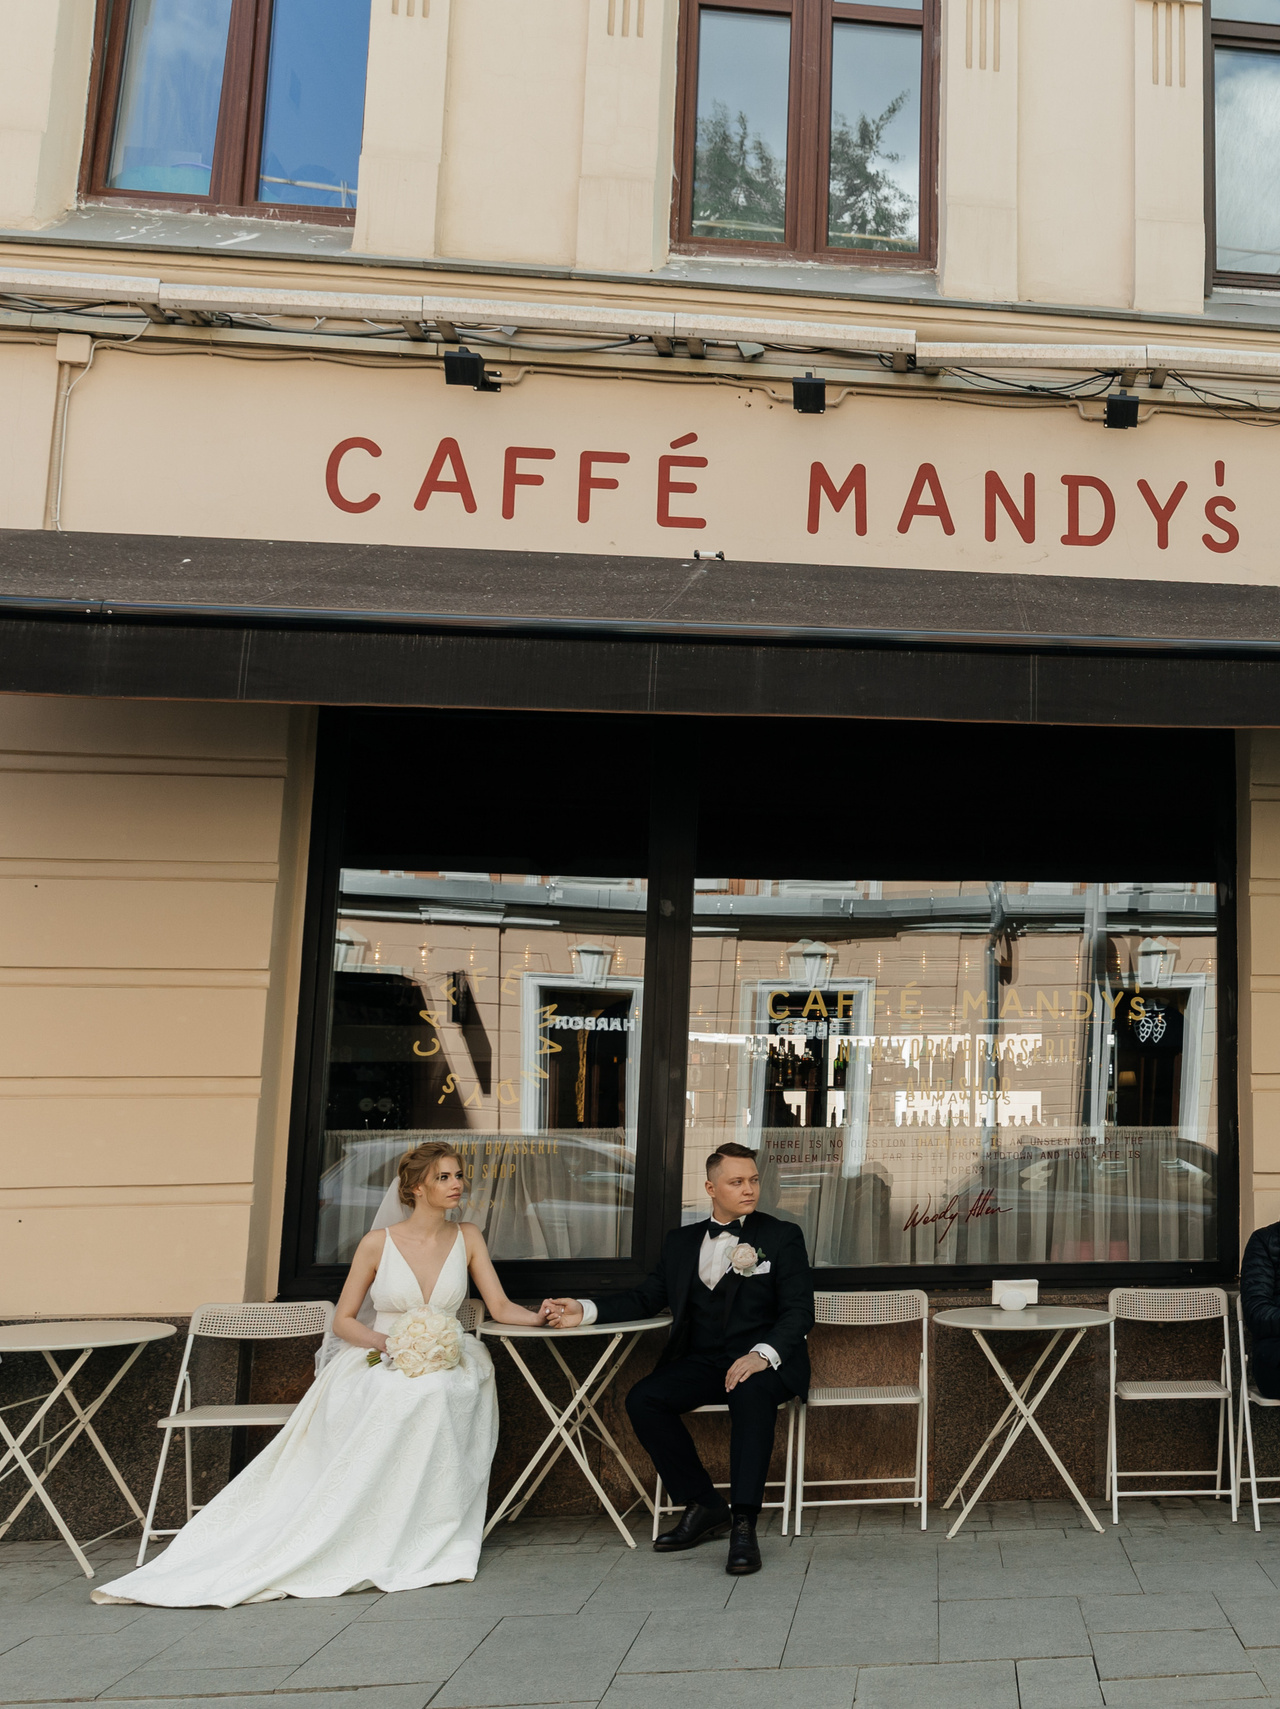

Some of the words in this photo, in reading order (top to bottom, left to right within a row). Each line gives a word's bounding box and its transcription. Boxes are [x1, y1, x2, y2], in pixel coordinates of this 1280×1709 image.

[325, 432, 709, 529] CAFFÉ
[767, 980, 922, 1020] CAFFÉ
[896, 1038, 952, 1062] YORK
[962, 1038, 1077, 1062] BRASSERIE
[959, 1076, 1012, 1101] SHOP
[485, 1139, 559, 1155] BRASSERIE
[766, 1140, 801, 1149] THERE
[809, 1139, 822, 1149] IS
[829, 1139, 844, 1148] NO
[850, 1138, 906, 1148] QUESTION
[914, 1138, 941, 1147] THAT
[948, 1138, 982, 1147] THERE
[990, 1137, 1003, 1147] IS
[1009, 1137, 1023, 1146] AN
[1030, 1137, 1071, 1146] UNSEEN
[1124, 1136, 1144, 1145] THE
[768, 1153, 818, 1163] PROBLEM
[854, 1153, 874, 1162] HOW
[882, 1153, 902, 1161] FAR
[910, 1153, 924, 1161] IS
[931, 1152, 944, 1161] IT
[952, 1152, 979, 1161] FROM
[985, 1151, 1033, 1160] MIDTOWN
[1040, 1151, 1060, 1160] AND
[1128, 1150, 1141, 1159] IS
[482, 1163, 516, 1179] SHOP
[931, 1166, 944, 1175] IT
[951, 1165, 985, 1175] OPEN?
